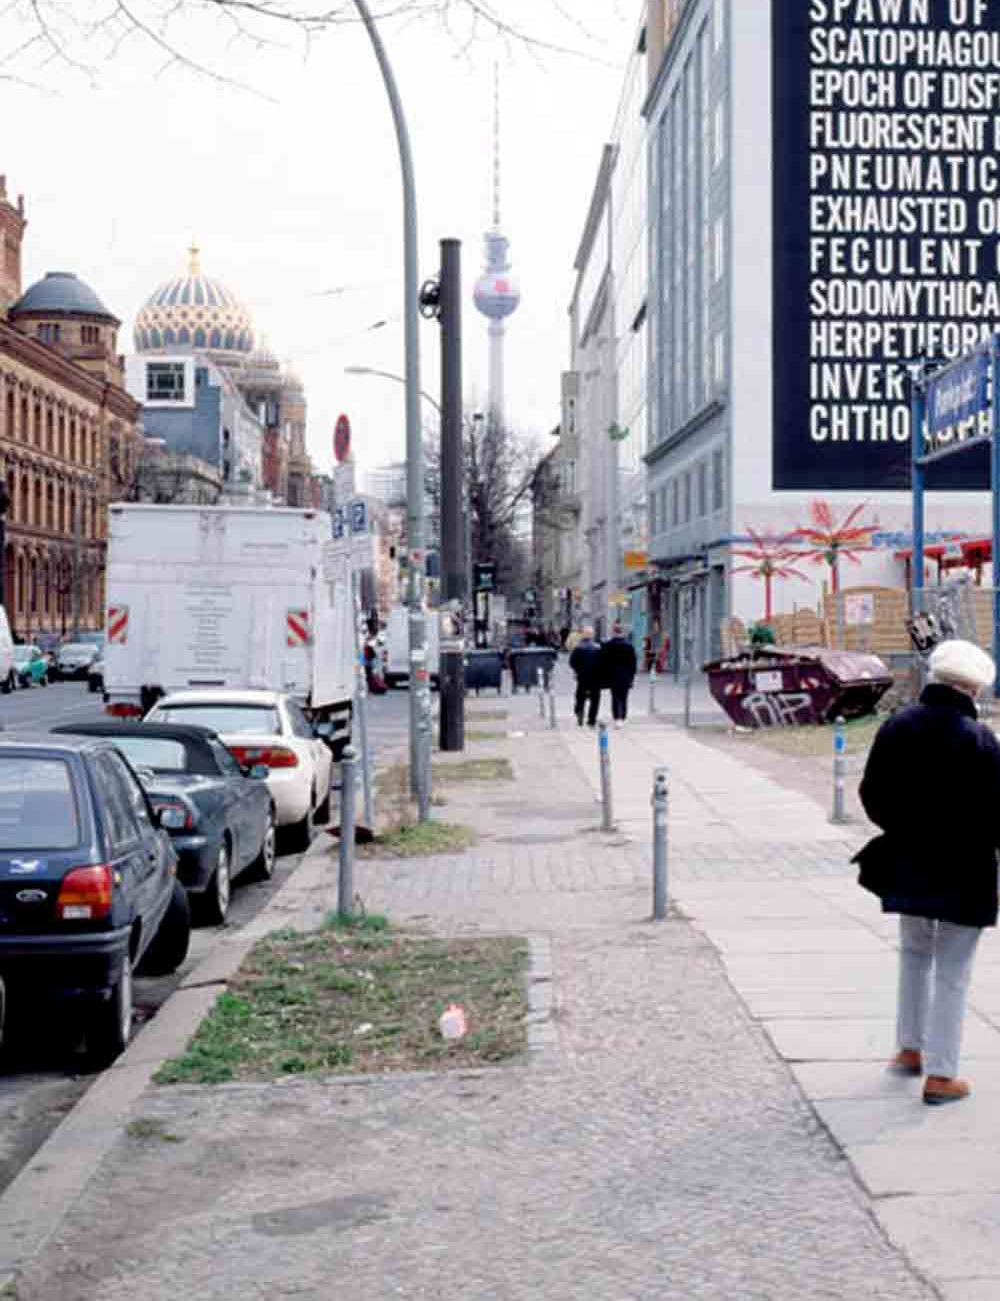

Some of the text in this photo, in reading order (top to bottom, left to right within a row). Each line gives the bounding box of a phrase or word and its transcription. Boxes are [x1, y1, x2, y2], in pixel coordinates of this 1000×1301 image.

[811, 70, 896, 106] EPOCH
[904, 72, 935, 107] OF
[811, 113, 988, 149] FLUORESCENT
[811, 154, 998, 191] PNEUMATIC
[811, 197, 967, 232] EXHAUSTED
[811, 239, 980, 274] FECULENT
